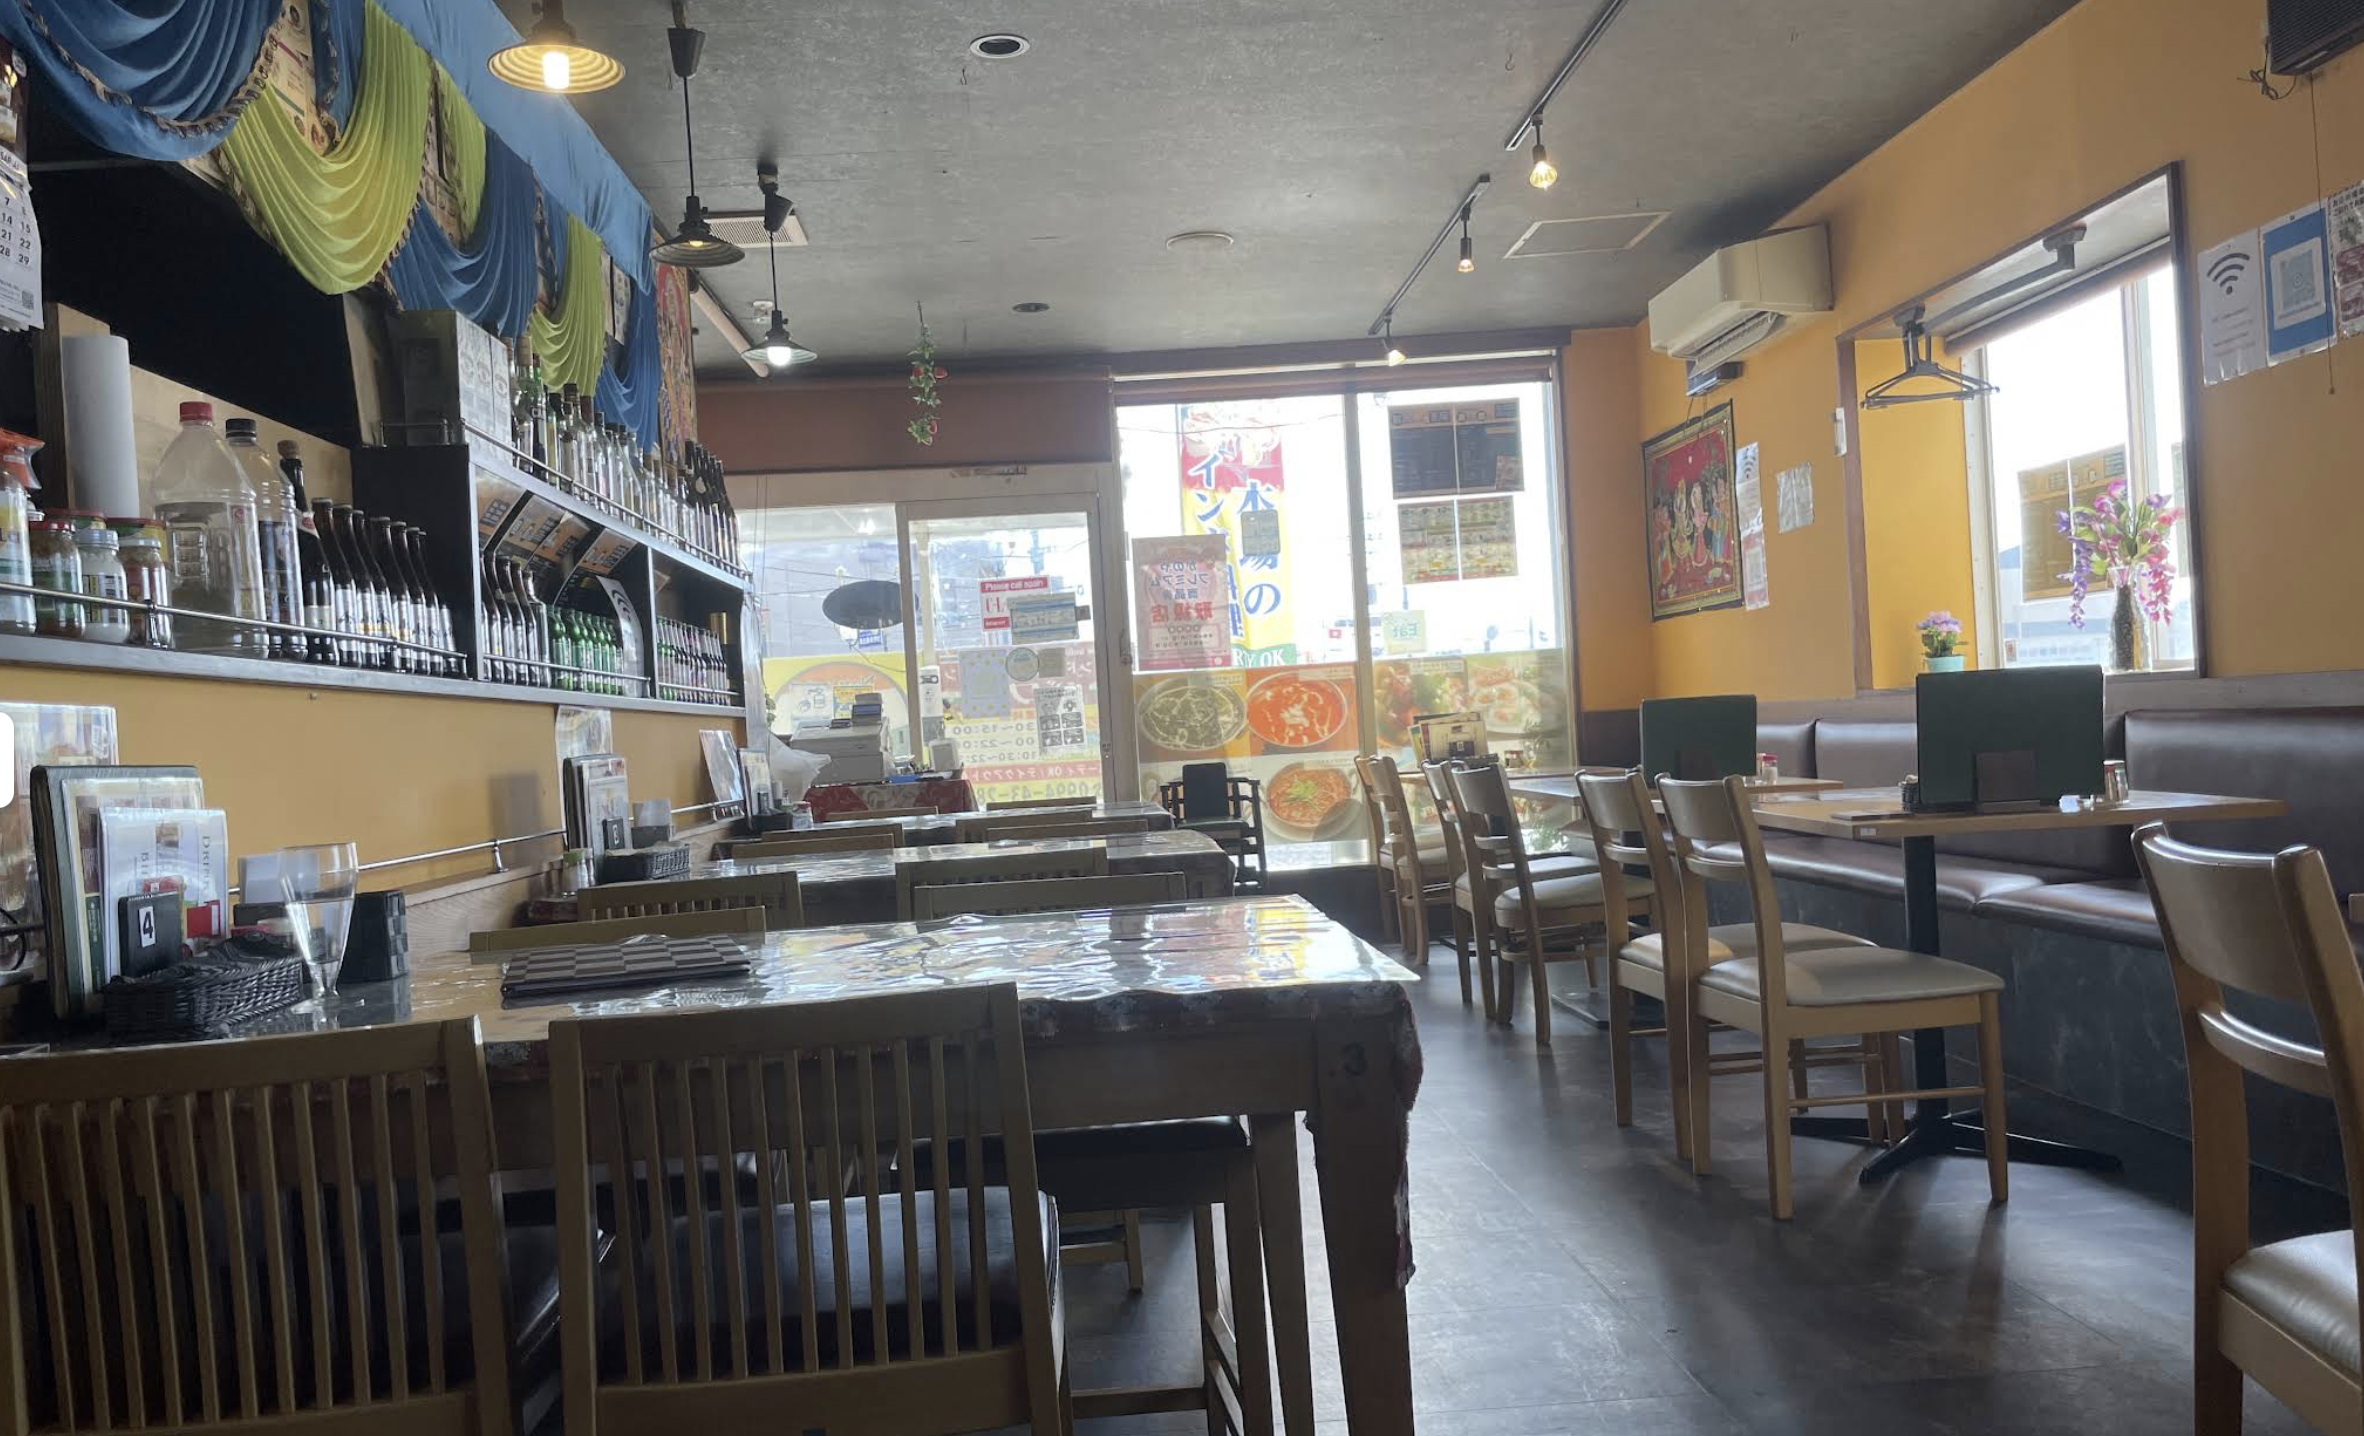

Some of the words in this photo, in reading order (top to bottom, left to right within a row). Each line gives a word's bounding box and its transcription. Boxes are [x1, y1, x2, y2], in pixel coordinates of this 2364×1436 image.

[4, 196, 10, 207] 7
[1, 212, 13, 226] 14
[20, 221, 31, 234] 15
[1, 229, 12, 241] 21
[19, 237, 31, 250] 22
[0, 245, 11, 257] 28
[18, 253, 30, 265] 29
[1260, 648, 1286, 667] OK
[142, 911, 154, 939] 4
